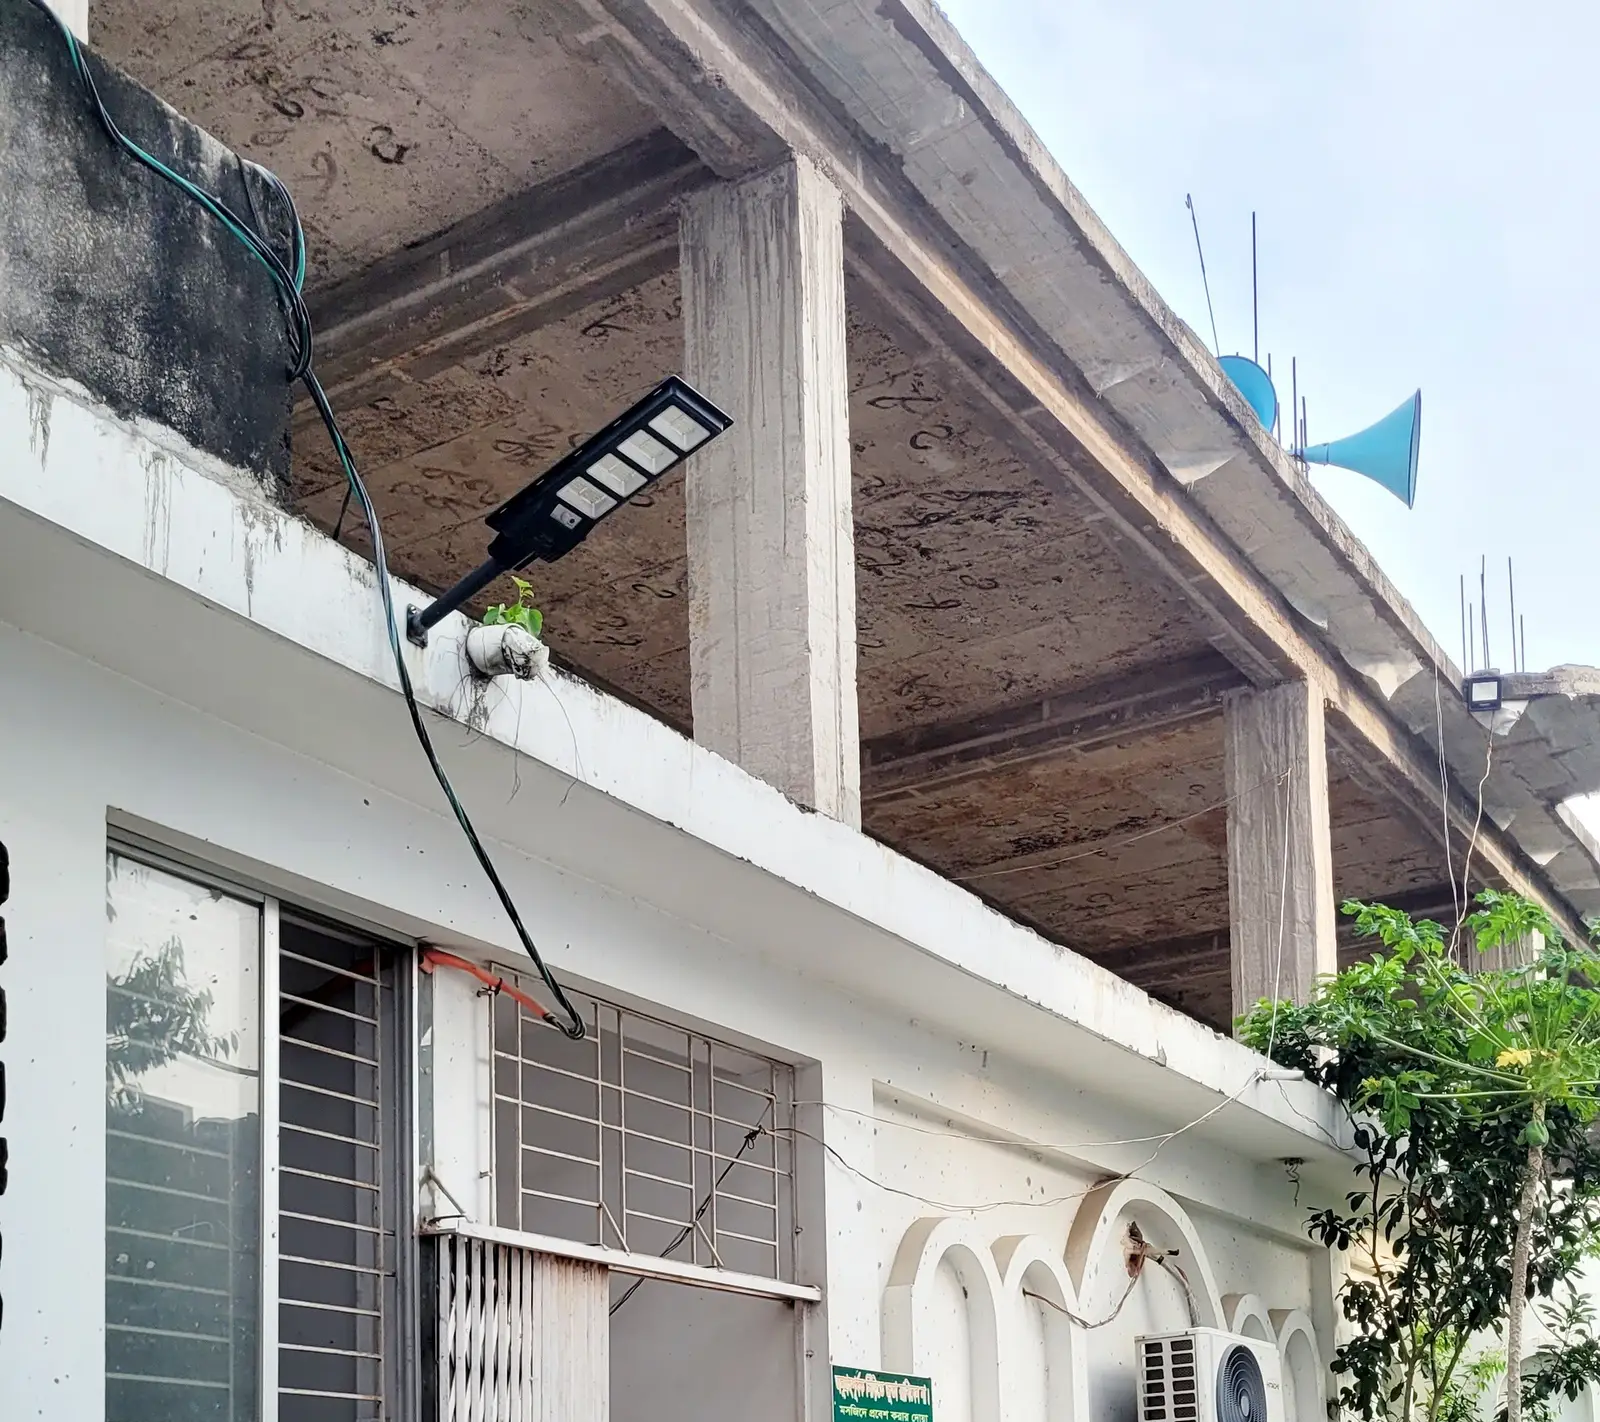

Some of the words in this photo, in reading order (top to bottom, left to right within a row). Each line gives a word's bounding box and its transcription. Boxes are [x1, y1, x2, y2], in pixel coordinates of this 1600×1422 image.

[839, 1403, 868, 1418] মসজিদে
[869, 1408, 889, 1420] প্রবেশ
[890, 1411, 910, 1422] করার
